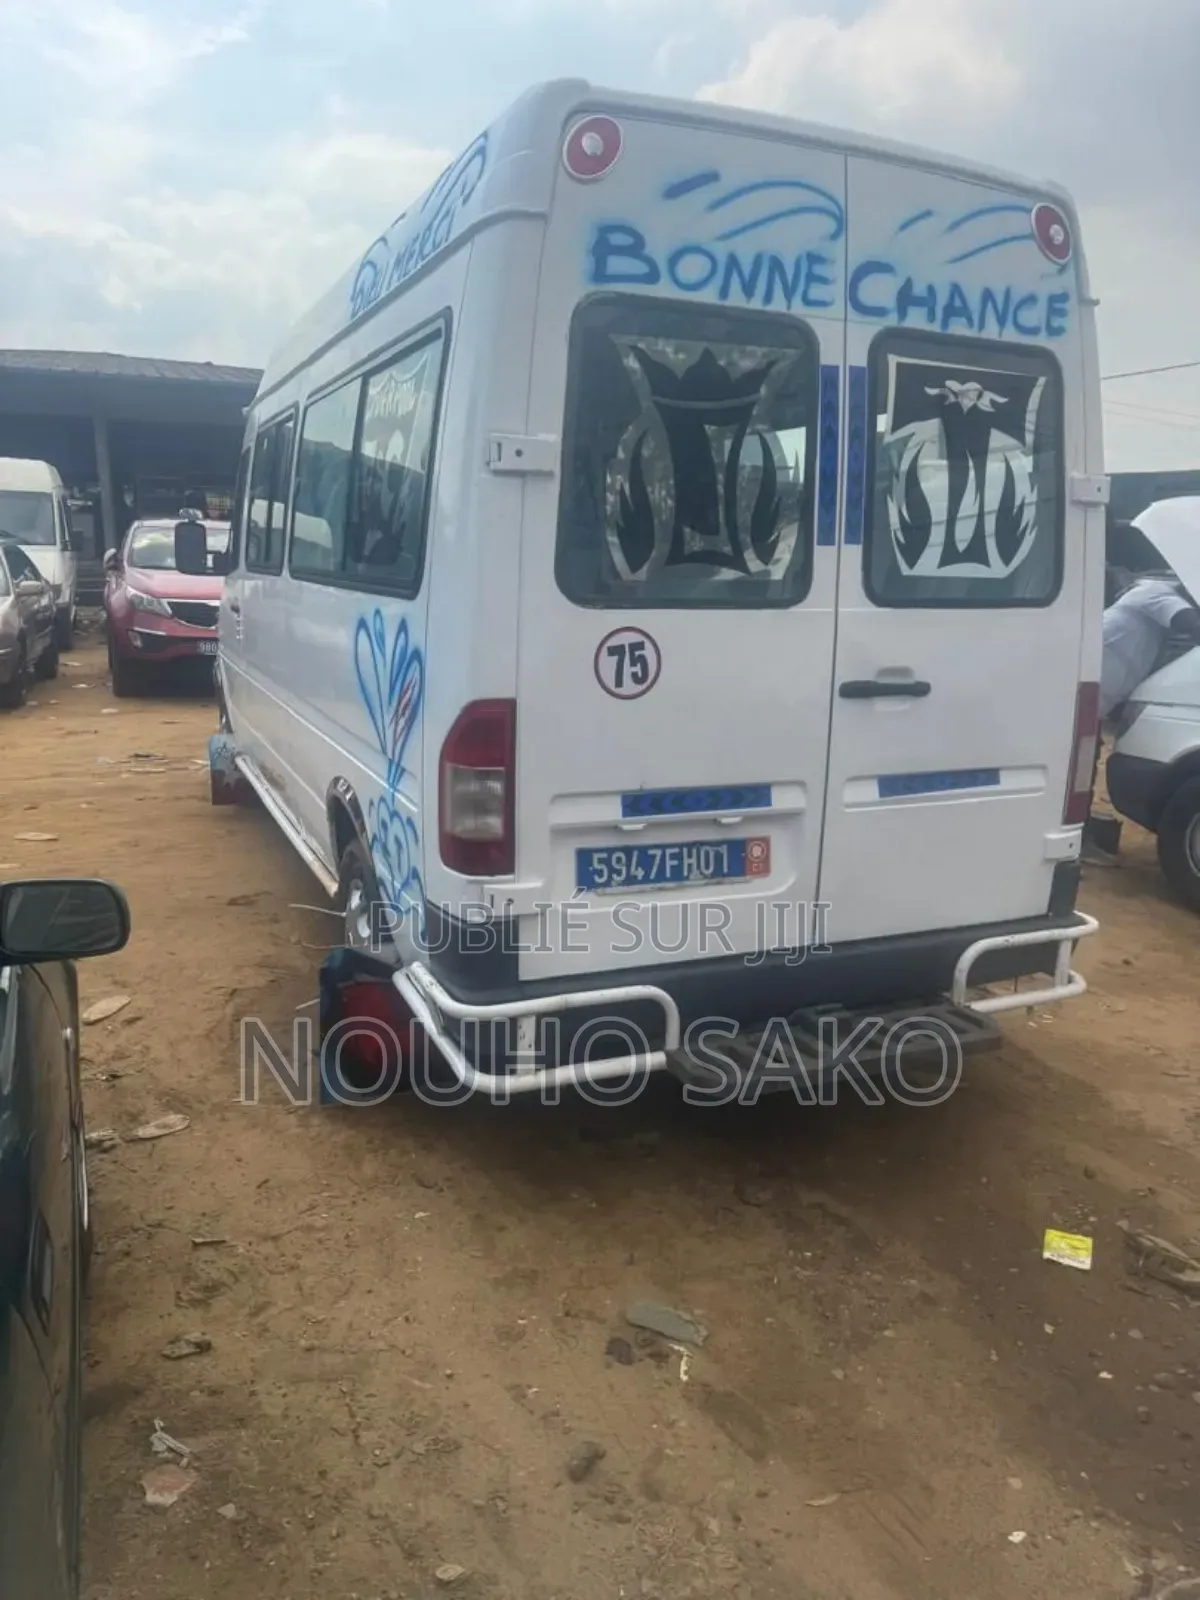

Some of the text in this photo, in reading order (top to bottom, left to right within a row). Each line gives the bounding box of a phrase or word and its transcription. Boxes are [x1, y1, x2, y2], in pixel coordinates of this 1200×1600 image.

[591, 223, 1071, 336] BONNE CHANCE
[606, 640, 649, 688] 75
[592, 844, 728, 883] 5947FH01
